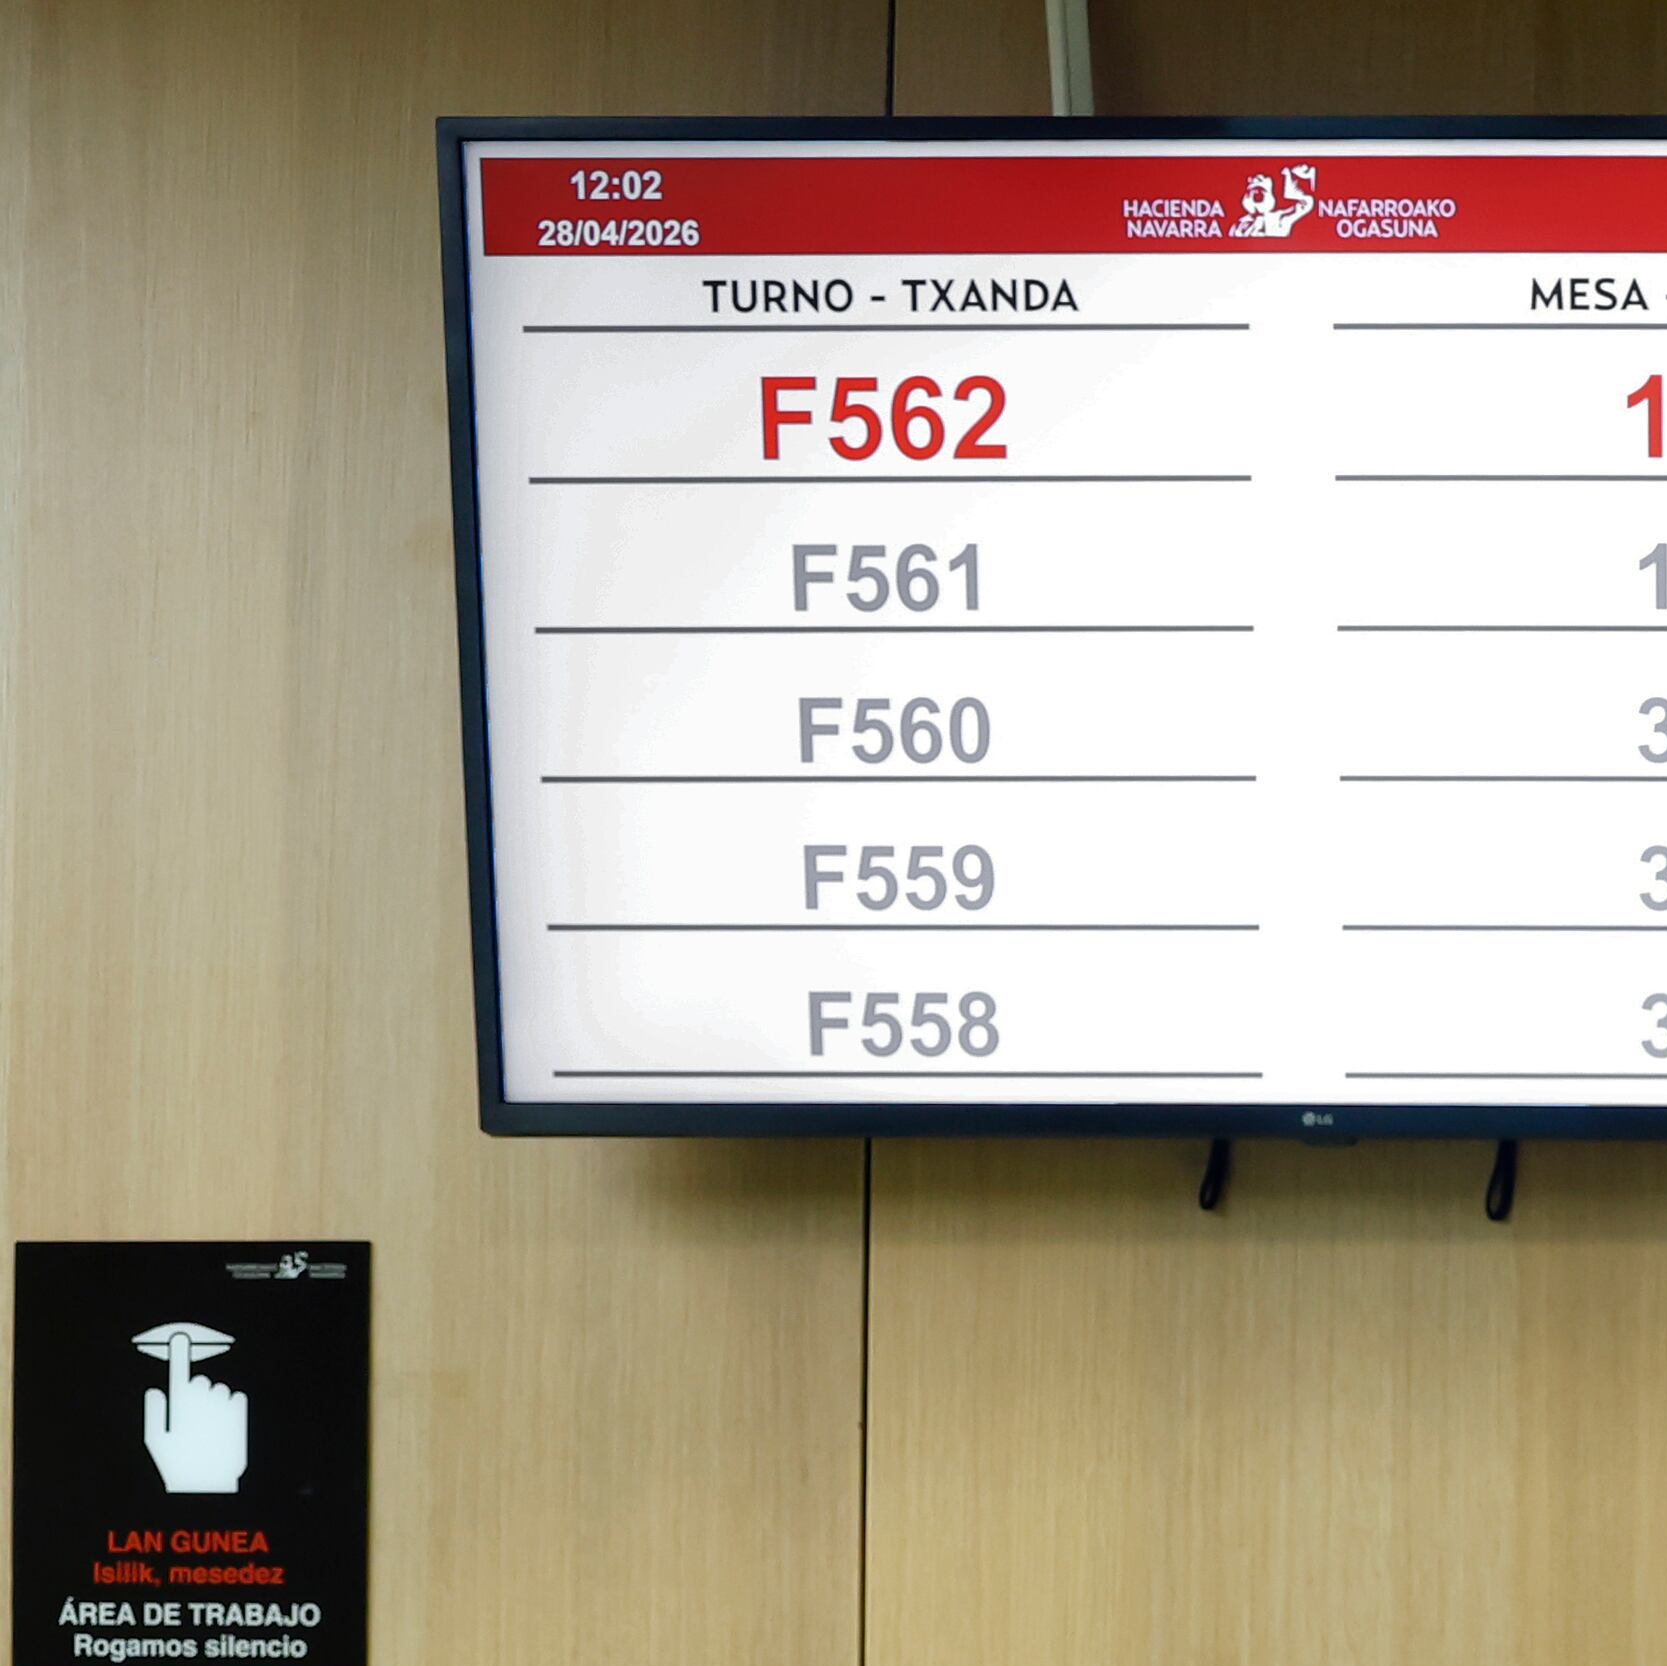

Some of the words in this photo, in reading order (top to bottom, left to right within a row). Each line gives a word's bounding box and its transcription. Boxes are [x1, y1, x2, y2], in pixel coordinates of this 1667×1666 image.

[571, 169, 662, 201] 12:02
[1123, 200, 1225, 218] HACIENDA
[1318, 198, 1456, 219] NAFARROAKO
[537, 218, 700, 248] 28/04/2026
[1126, 219, 1223, 238] NAVARRA
[1336, 218, 1439, 239] OGASUNA
[702, 278, 854, 314] TURNO
[901, 278, 1079, 313] TXANDA
[1530, 277, 1650, 312] MESA
[759, 374, 1009, 461] F562
[791, 542, 980, 612] F561
[798, 695, 992, 765] F560
[802, 843, 996, 912] F559
[807, 990, 1000, 1059] F558
[107, 1530, 164, 1553] LAN
[170, 1530, 270, 1554] GUNEA
[93, 1561, 162, 1587] Isilik,
[169, 1561, 285, 1585] mesedez
[58, 1596, 136, 1627] ÁREA
[143, 1602, 182, 1627] DE
[187, 1602, 322, 1628] TRABAJO
[73, 1633, 198, 1663] Rogamos
[203, 1634, 309, 1659] silencio
